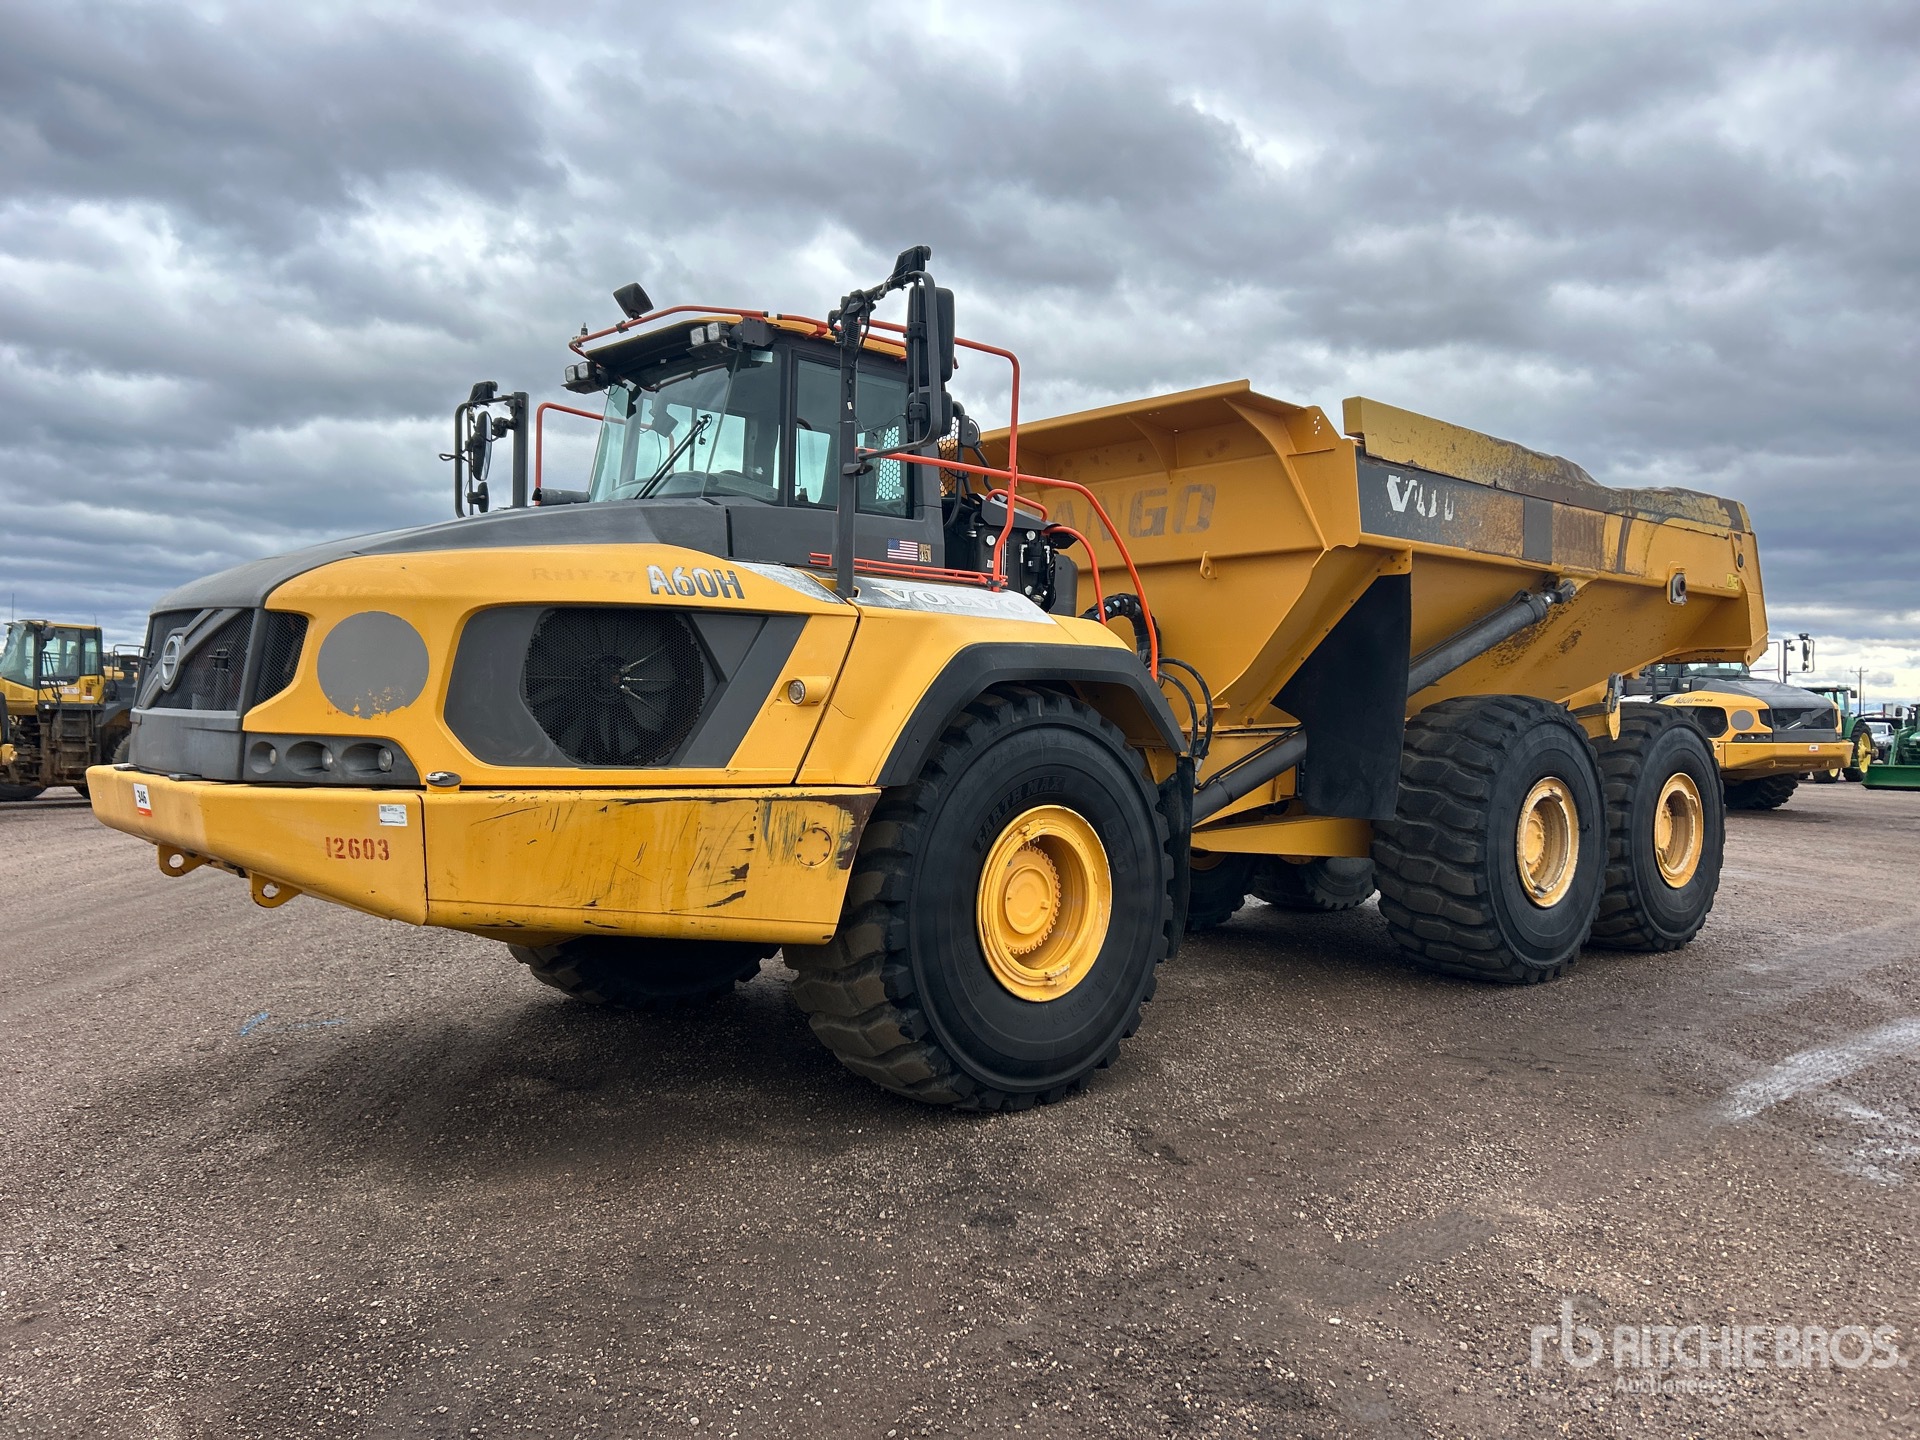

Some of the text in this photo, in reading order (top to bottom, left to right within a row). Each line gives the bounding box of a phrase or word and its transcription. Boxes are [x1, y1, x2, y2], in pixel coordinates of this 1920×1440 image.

[646, 564, 745, 599] A60H
[871, 586, 1030, 616] VOLVO
[976, 777, 1065, 849] EARTH MAX
[325, 836, 390, 861] 12603
